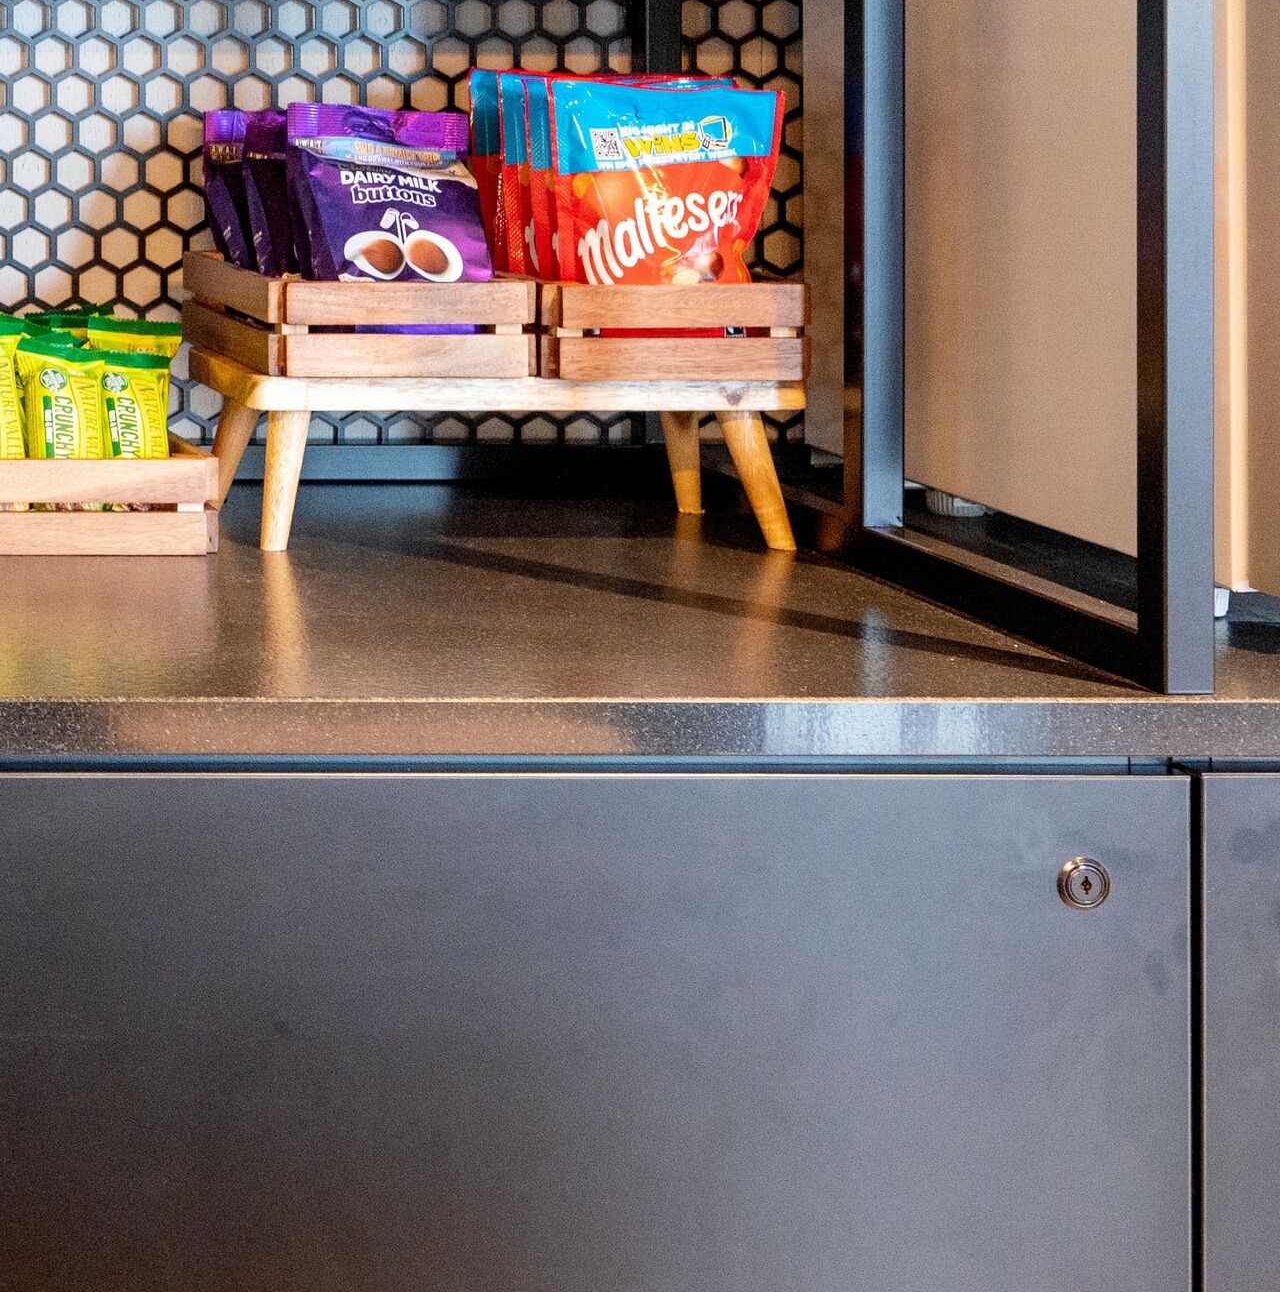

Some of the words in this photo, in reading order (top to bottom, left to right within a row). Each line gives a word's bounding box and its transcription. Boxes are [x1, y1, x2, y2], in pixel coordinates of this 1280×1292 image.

[340, 170, 396, 186] DAIRY
[398, 175, 442, 194] MILK
[352, 186, 437, 208] buttons
[54, 395, 75, 458] CRUNCHY
[117, 395, 140, 458] CRUNCHY
